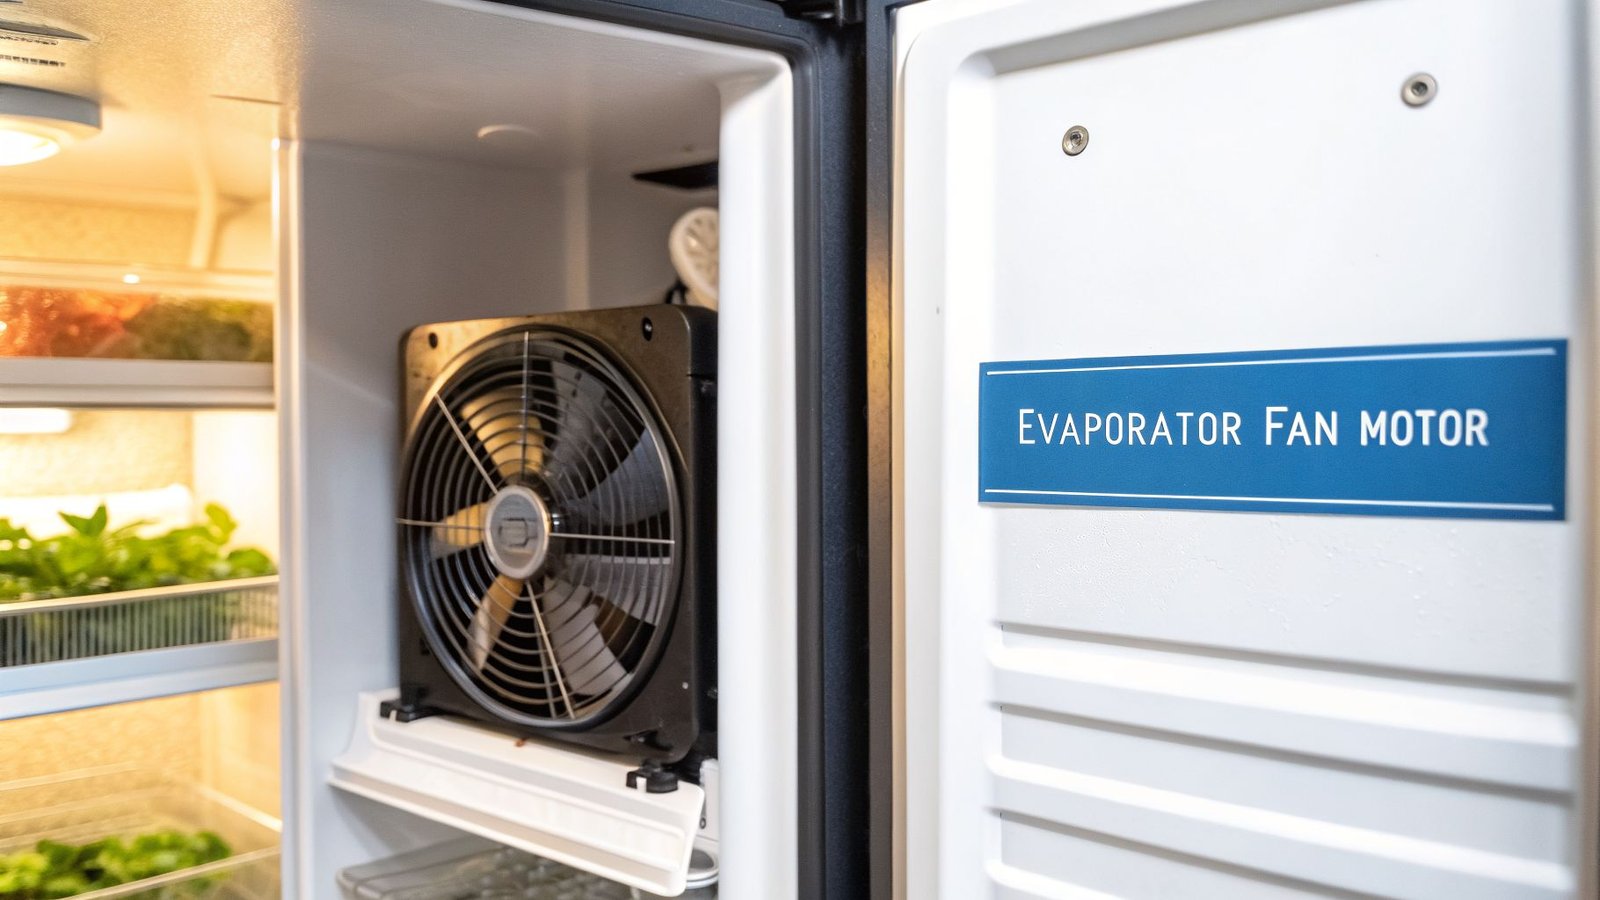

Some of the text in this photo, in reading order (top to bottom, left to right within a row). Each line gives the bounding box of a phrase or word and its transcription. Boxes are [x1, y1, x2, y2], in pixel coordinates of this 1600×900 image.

[1018, 406, 1489, 447] EVAPORATOR FAN MOTOR
